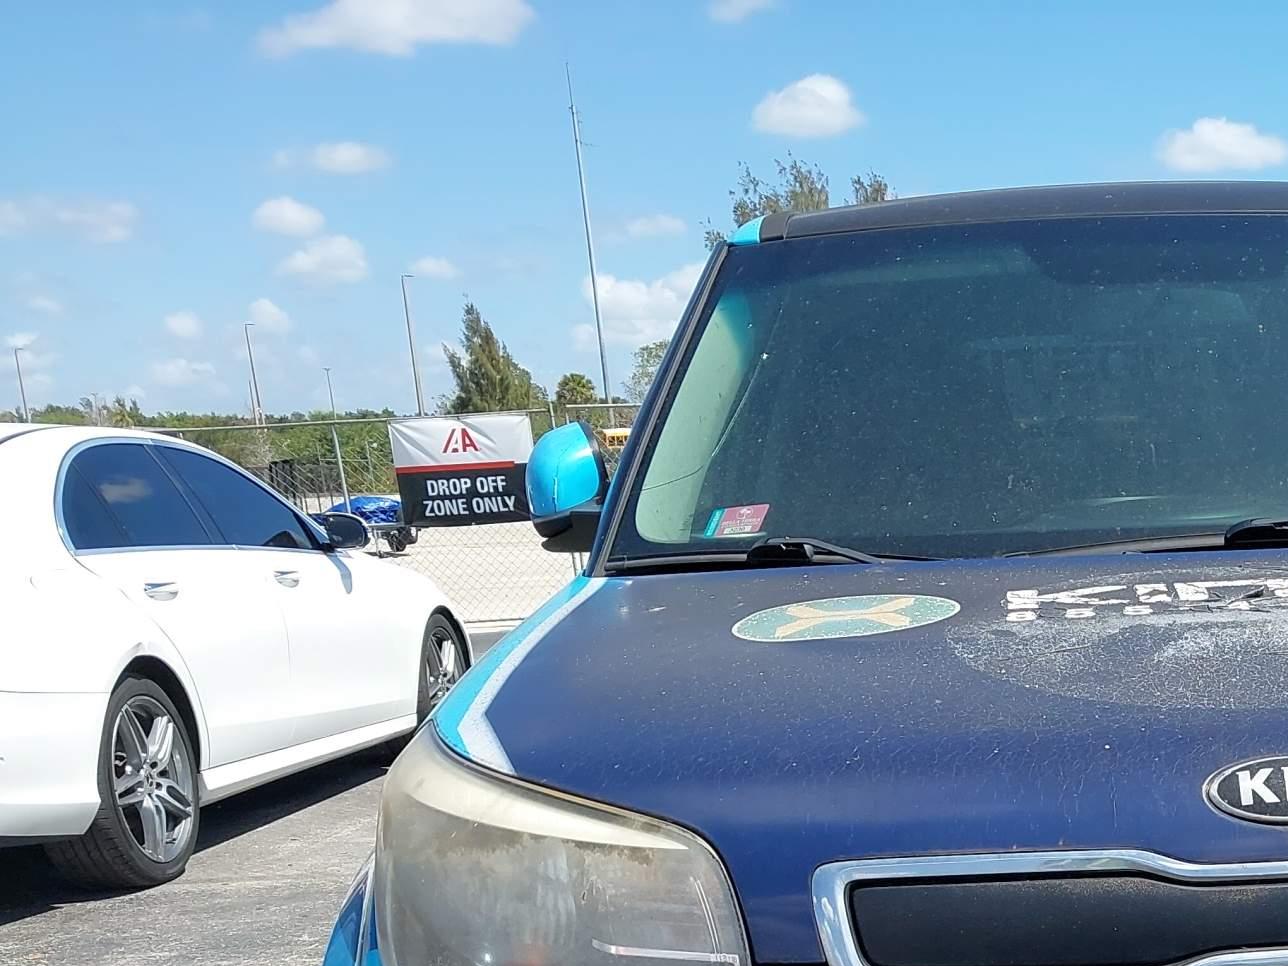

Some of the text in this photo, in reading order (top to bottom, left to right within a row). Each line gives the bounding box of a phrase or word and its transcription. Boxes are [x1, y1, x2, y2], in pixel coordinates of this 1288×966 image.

[426, 475, 507, 497] DROP OFF
[423, 495, 516, 517] ZONE ONLY
